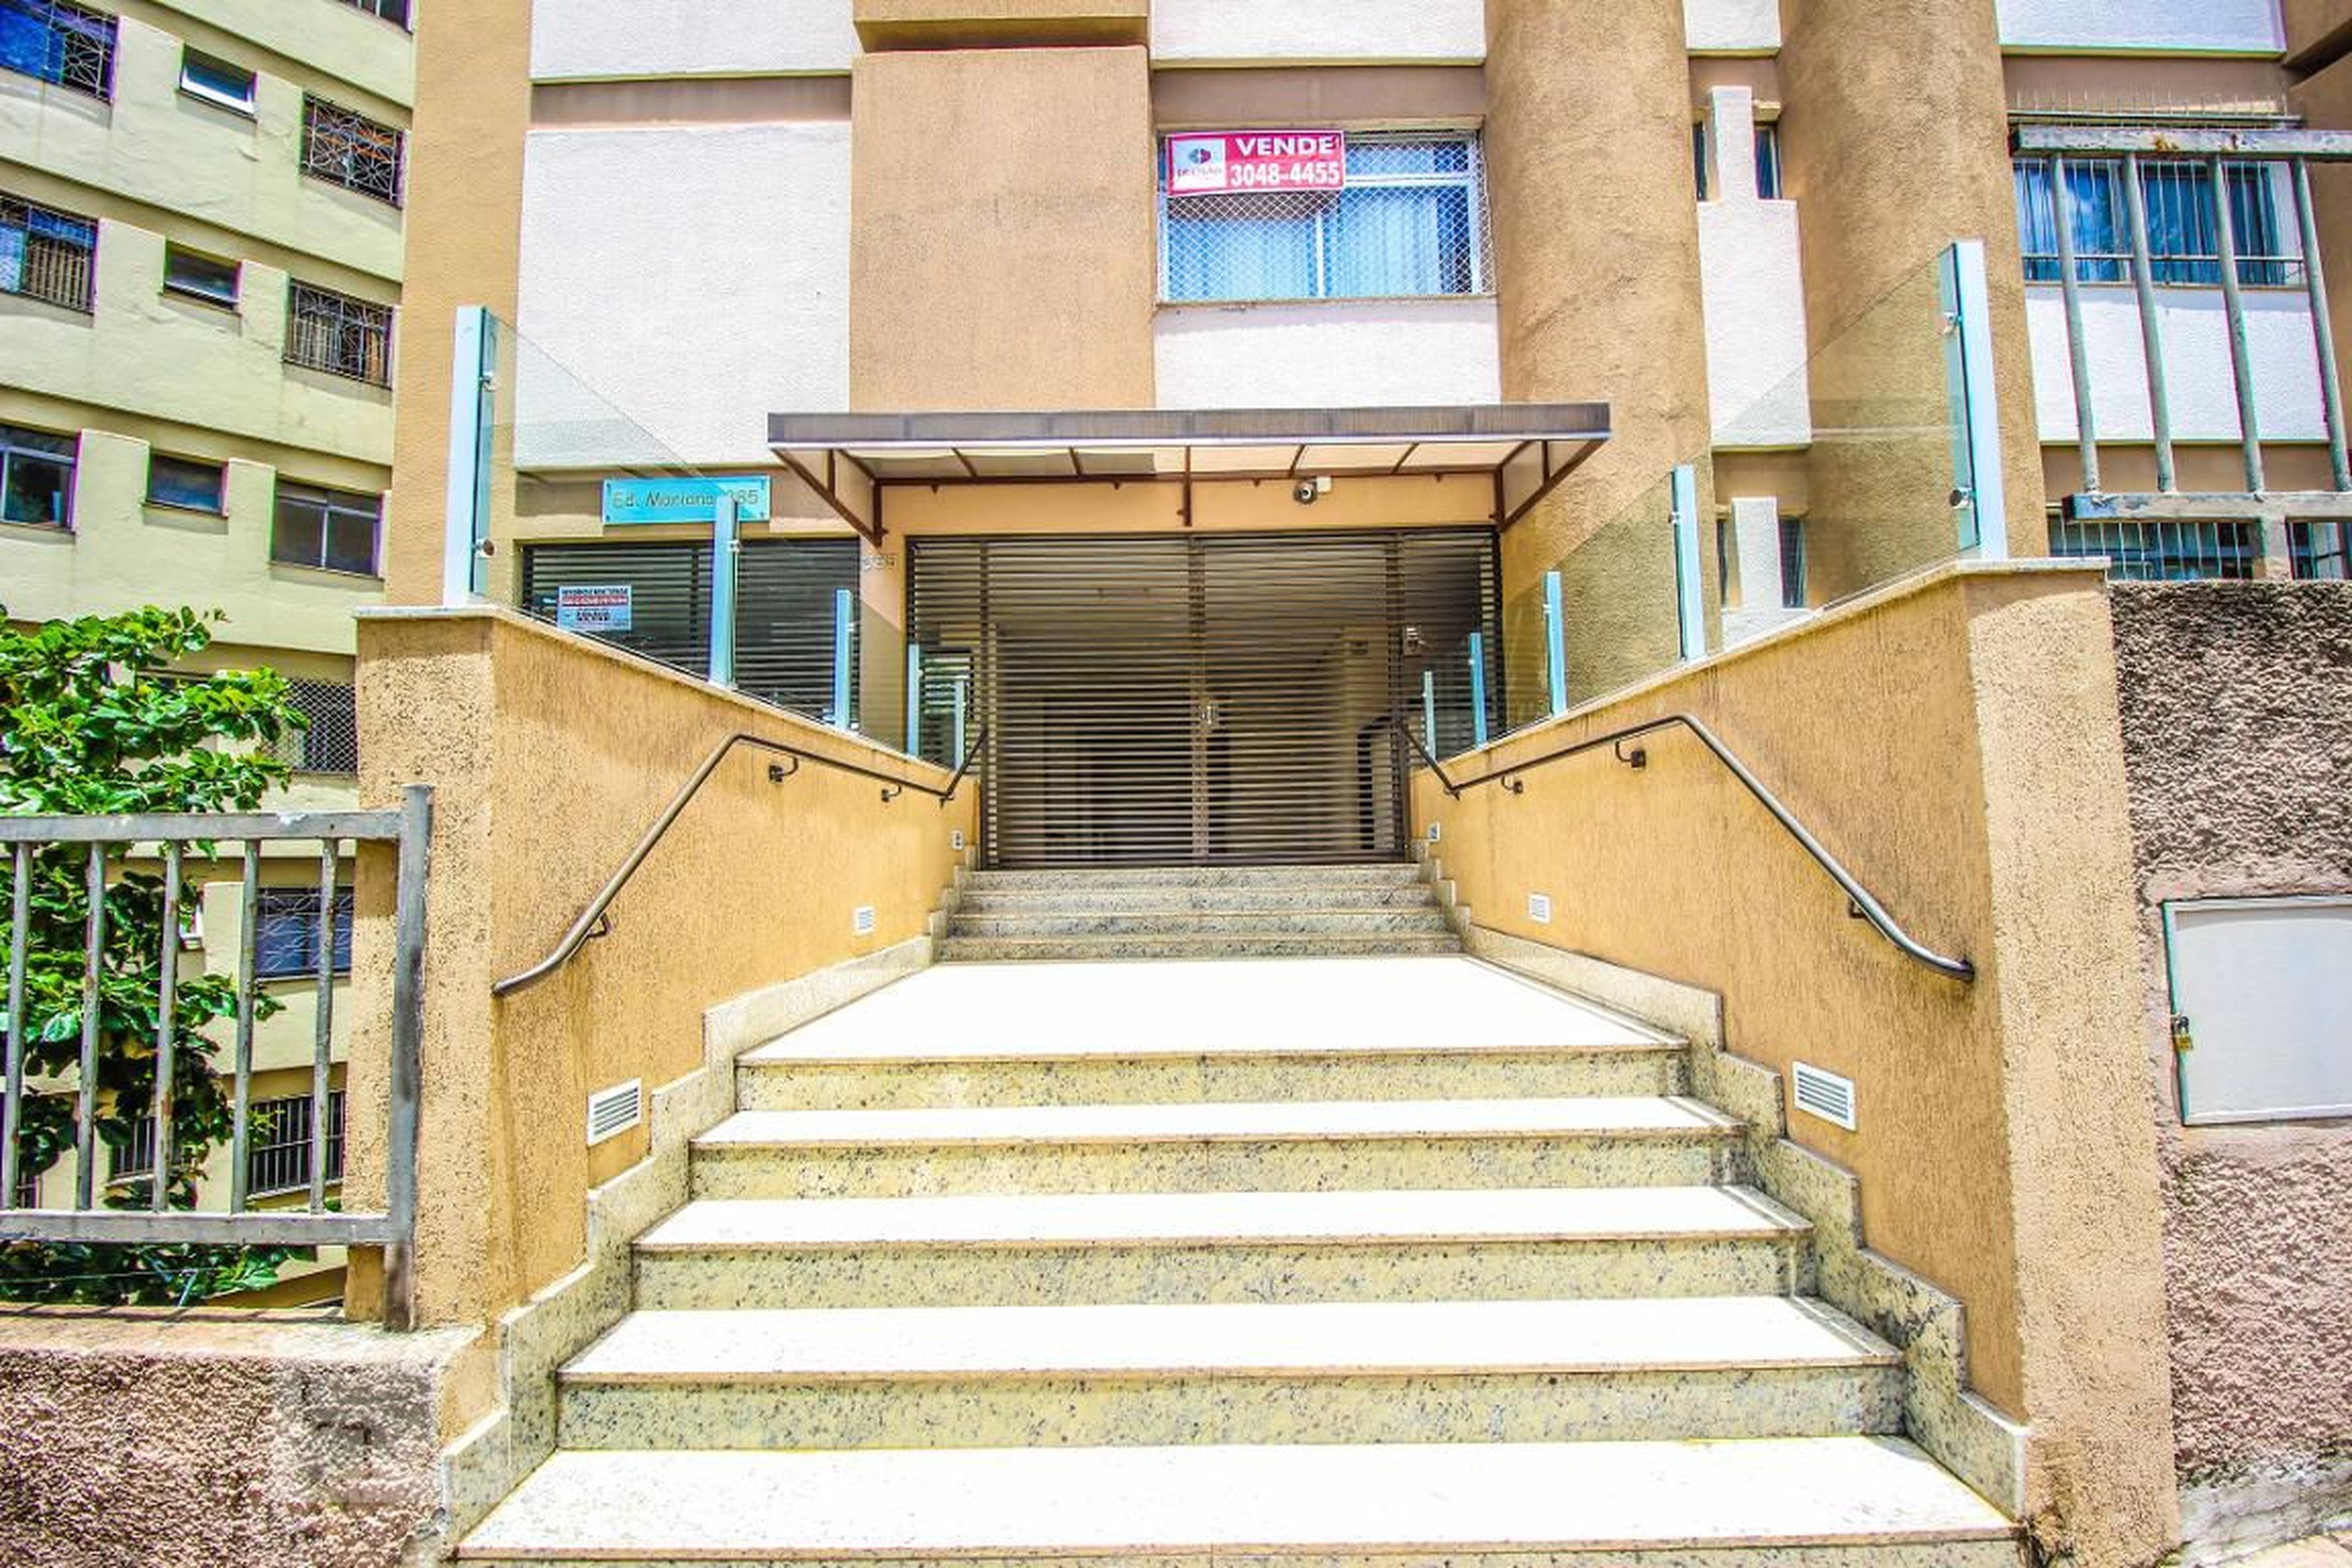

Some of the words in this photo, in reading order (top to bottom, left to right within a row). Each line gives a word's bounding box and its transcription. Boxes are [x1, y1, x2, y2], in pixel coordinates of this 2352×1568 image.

[1236, 137, 1333, 157] VENDE
[1230, 162, 1340, 187] 3048-4455
[613, 491, 639, 508] Ed.
[645, 490, 714, 507] Mariana
